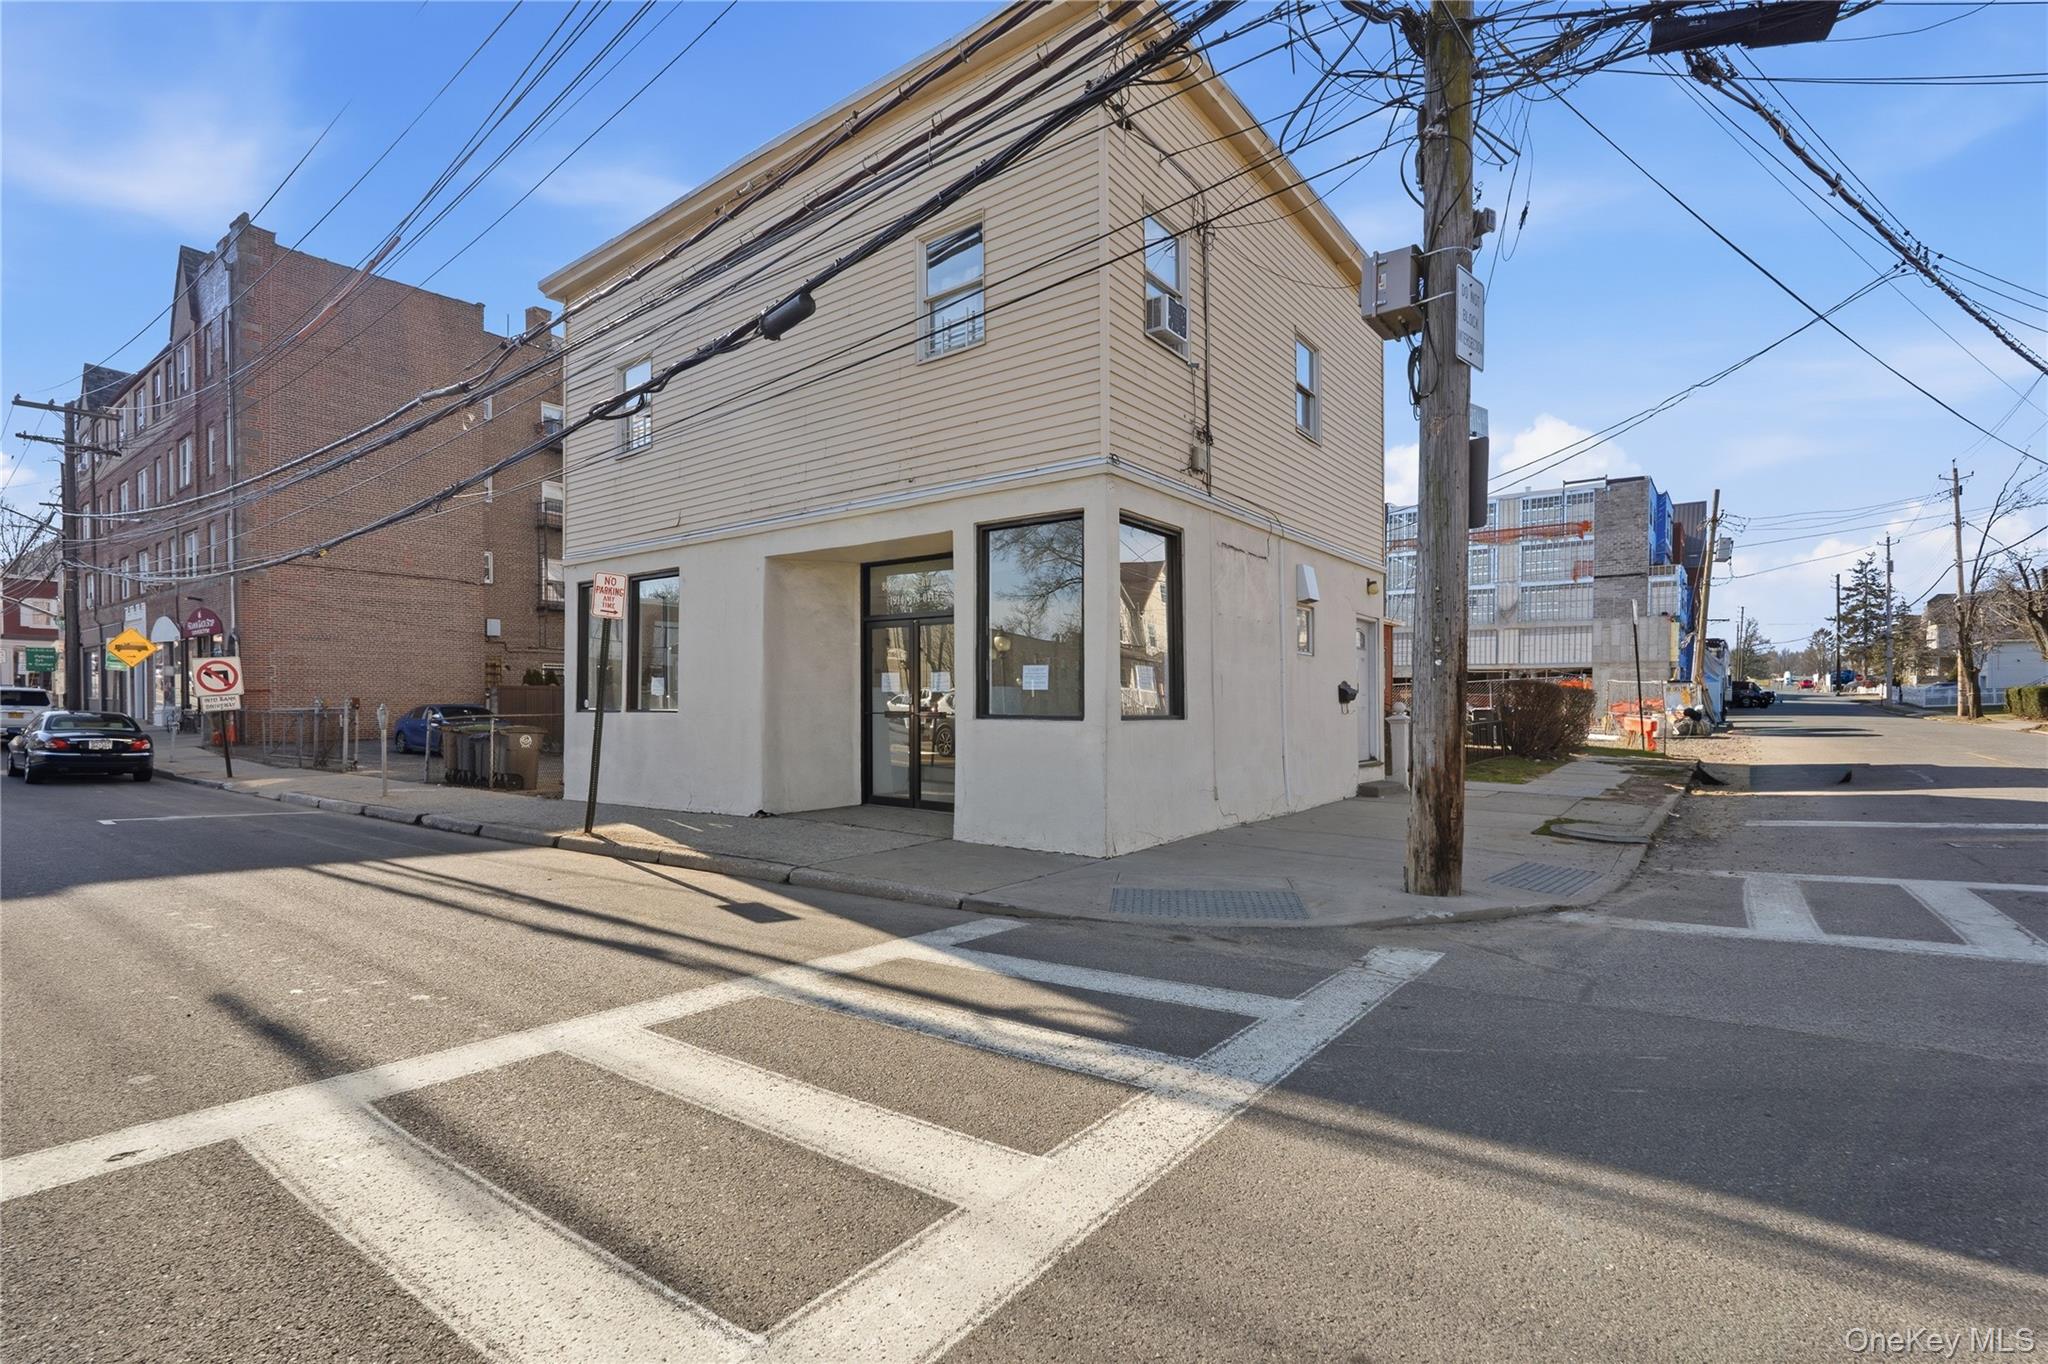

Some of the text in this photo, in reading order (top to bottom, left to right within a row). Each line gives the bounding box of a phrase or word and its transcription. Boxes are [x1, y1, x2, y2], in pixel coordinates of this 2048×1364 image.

[1461, 283, 1480, 309] DO NOT
[1462, 309, 1479, 329] BLOCK
[604, 576, 617, 586] NO
[596, 586, 624, 597] PARKING
[602, 601, 615, 609] TIME
